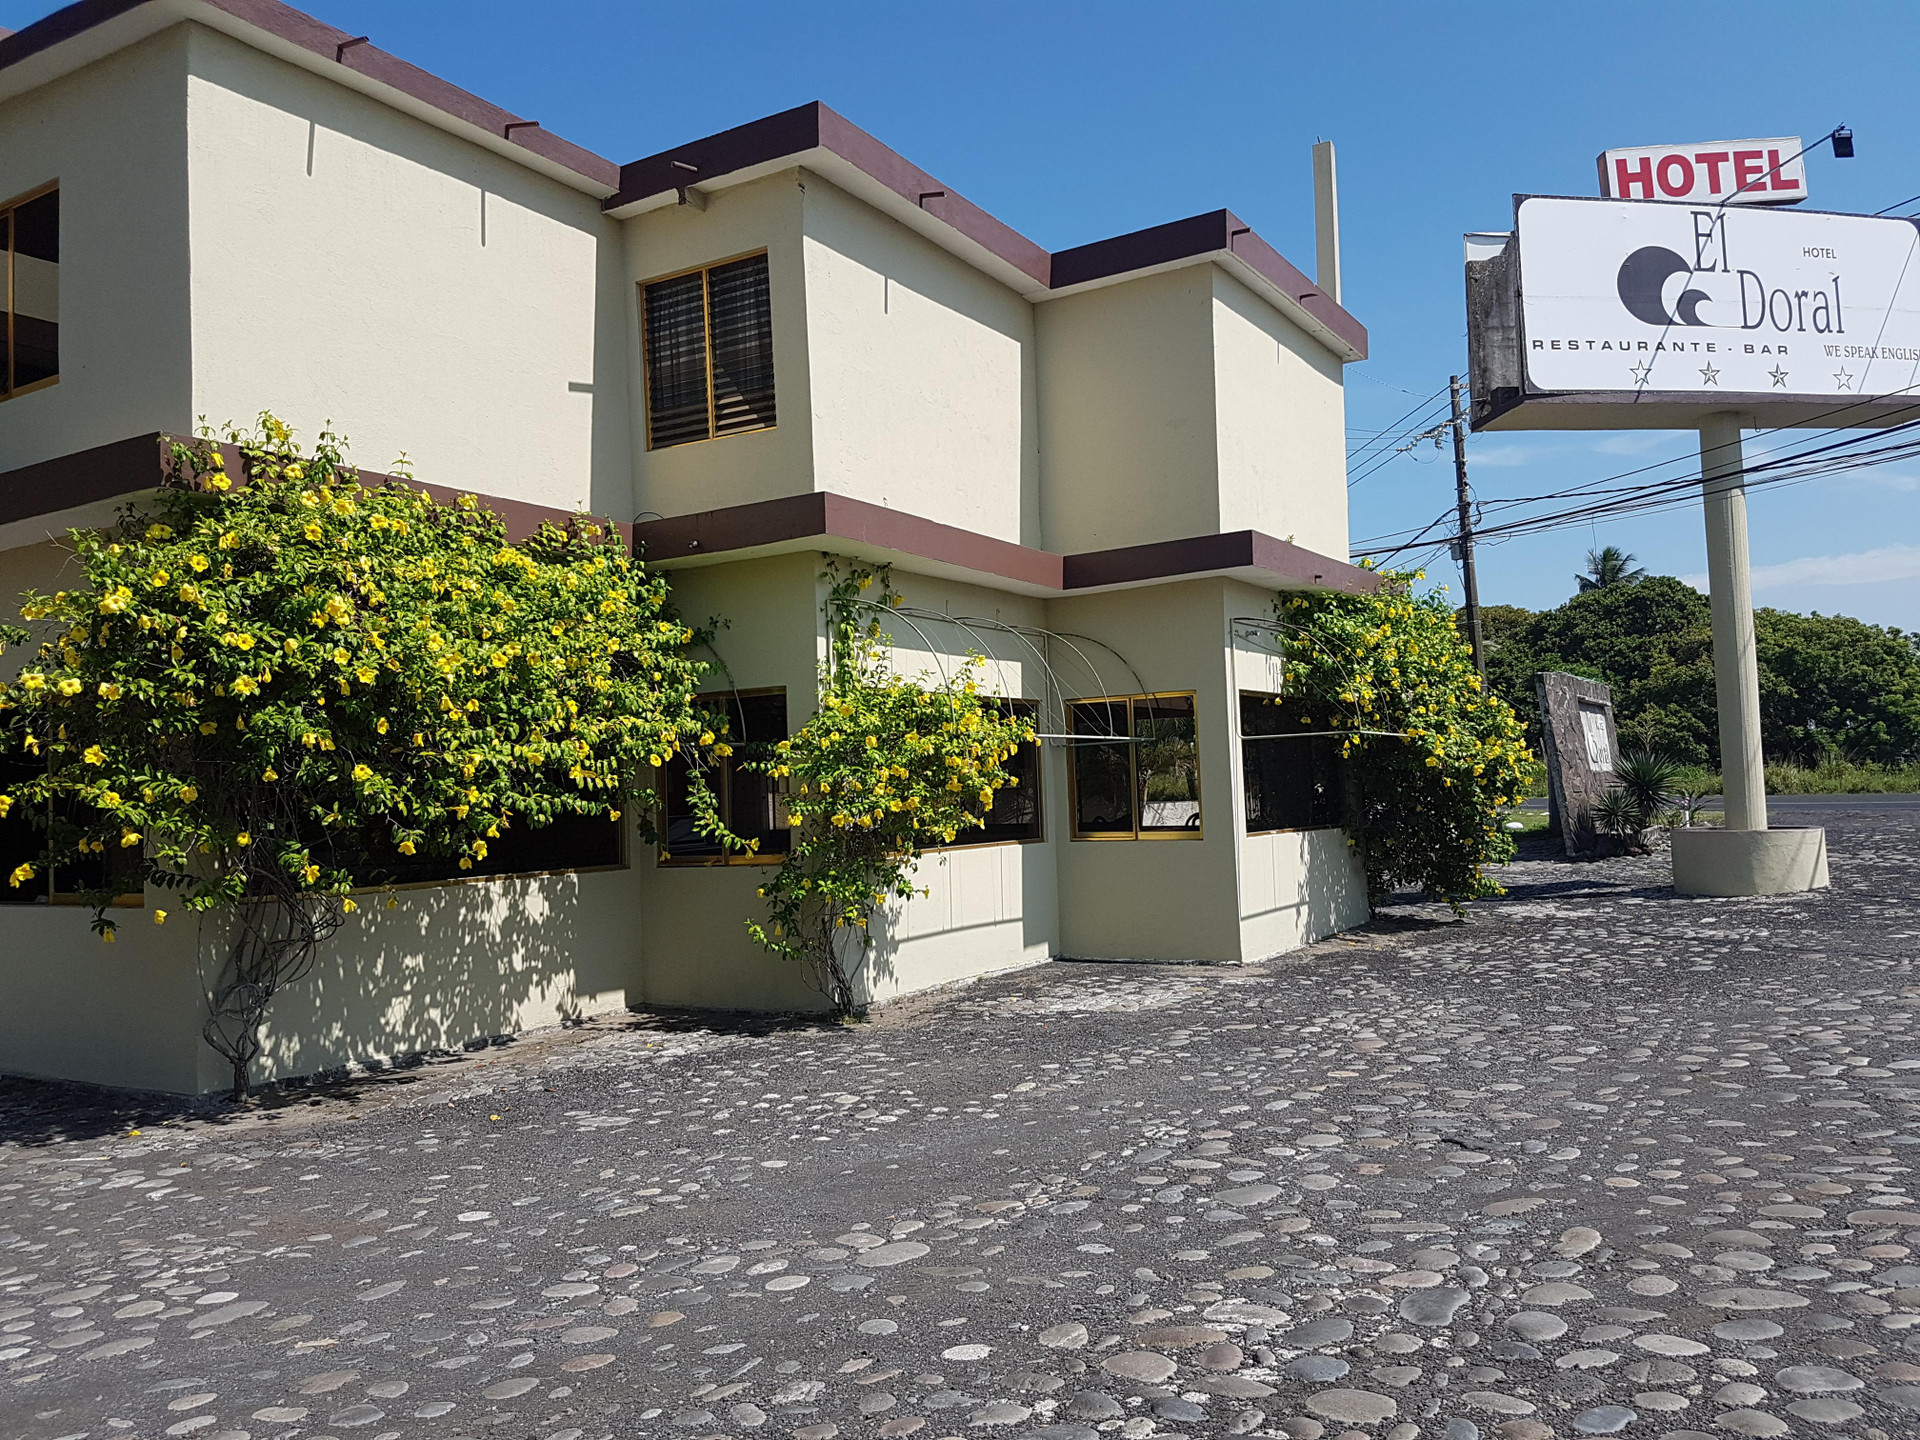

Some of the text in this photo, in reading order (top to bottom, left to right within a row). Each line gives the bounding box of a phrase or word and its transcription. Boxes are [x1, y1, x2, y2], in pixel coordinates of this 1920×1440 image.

[1615, 149, 1800, 199] HOTEL
[1690, 210, 1730, 273] El
[1802, 246, 1837, 259] HOTEL
[1736, 269, 1845, 334] Doral
[1532, 339, 1717, 352] RESTAURANTE
[1744, 343, 1789, 355] BAR
[1823, 344, 1920, 361] WE SPEAK ENGLIS
